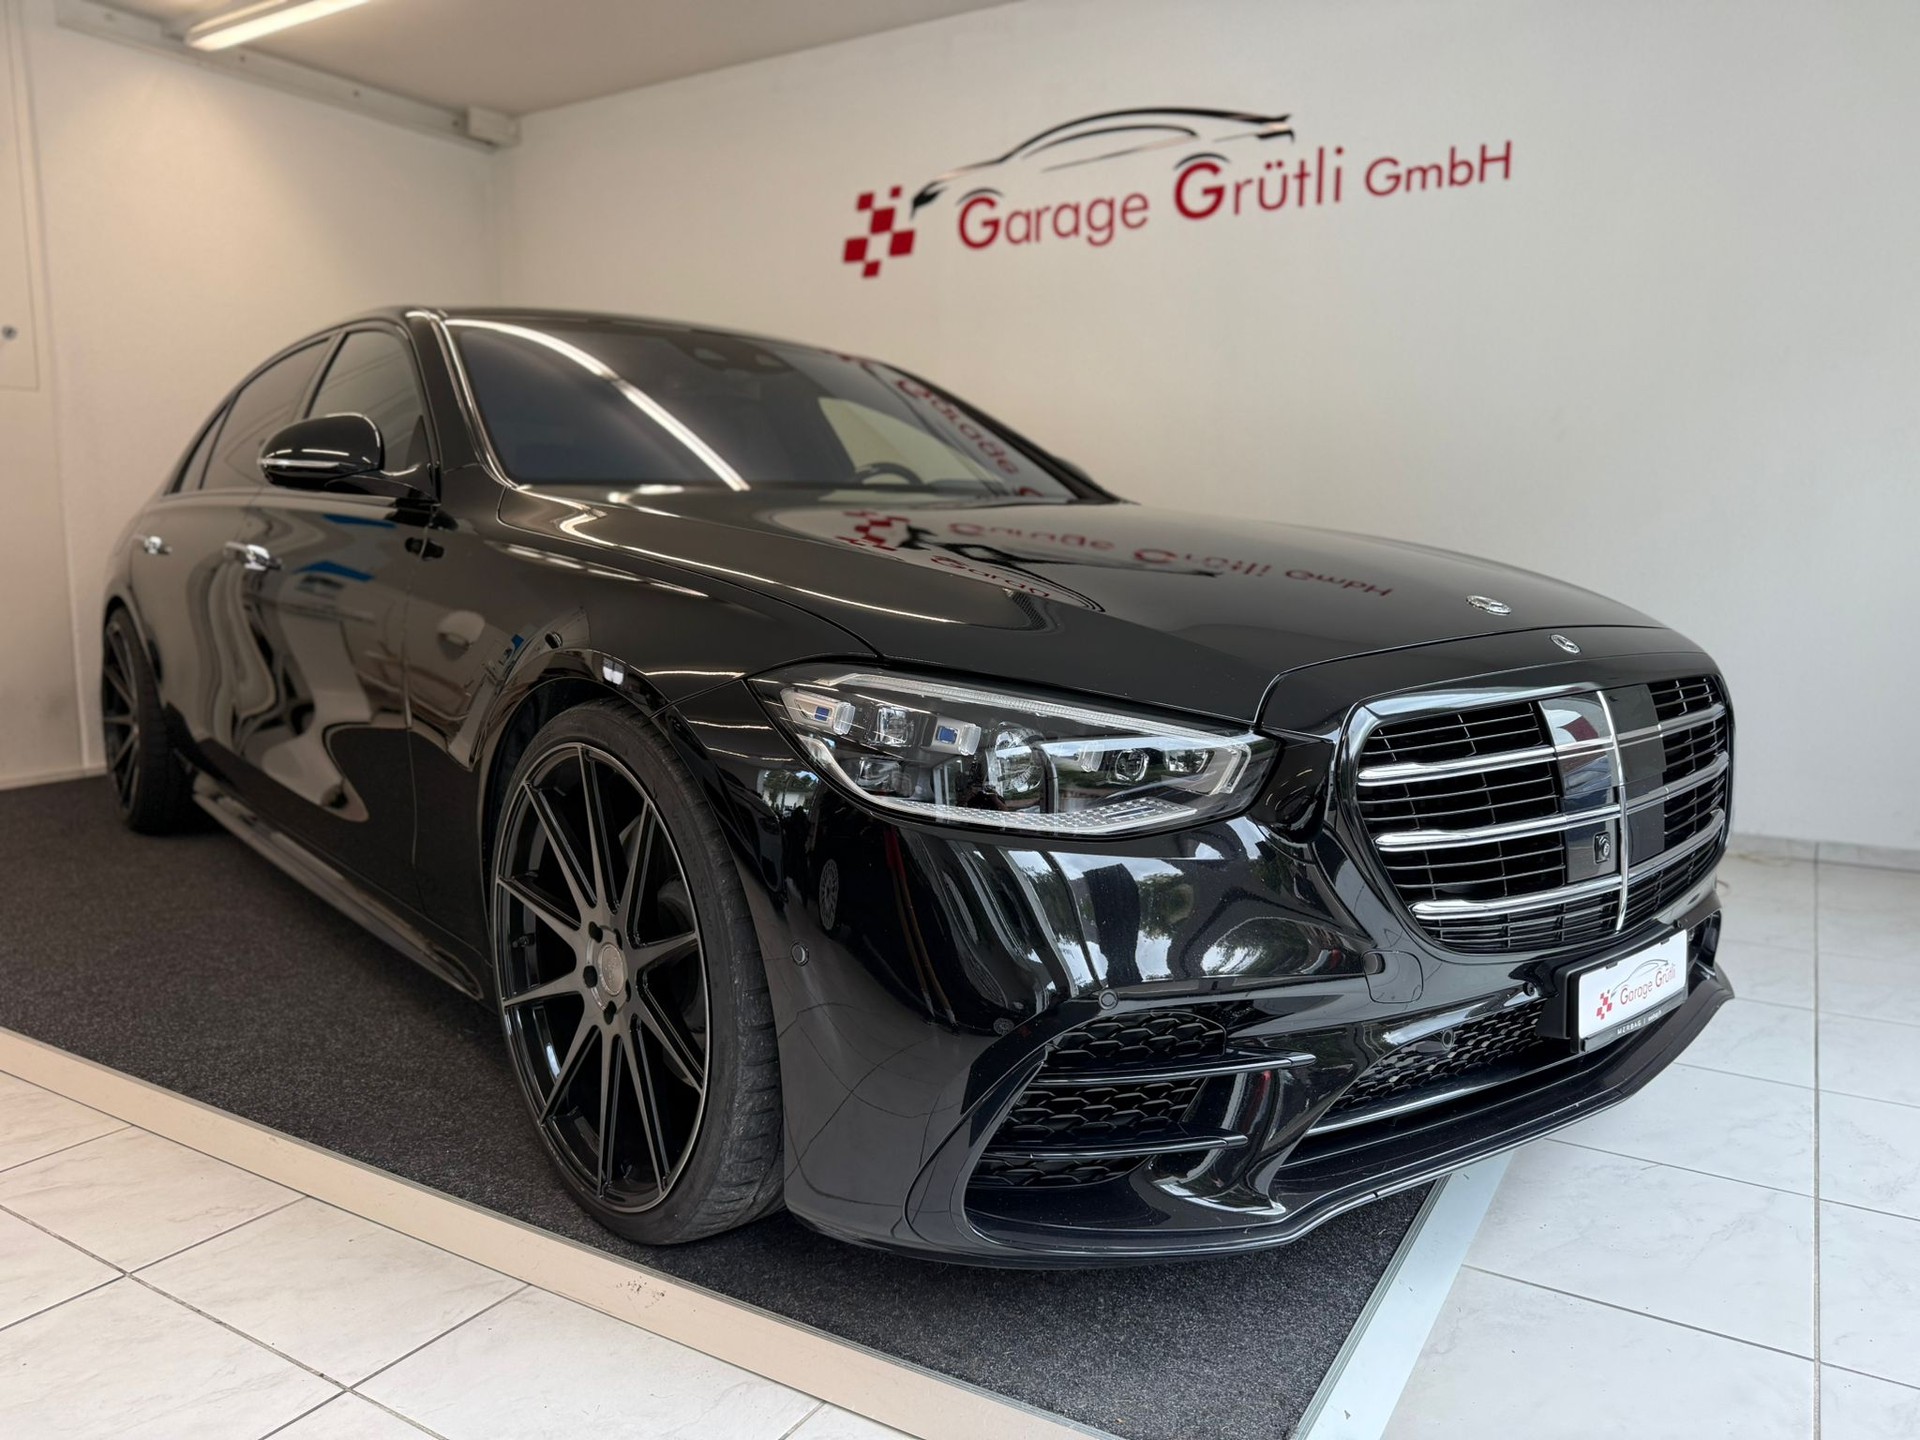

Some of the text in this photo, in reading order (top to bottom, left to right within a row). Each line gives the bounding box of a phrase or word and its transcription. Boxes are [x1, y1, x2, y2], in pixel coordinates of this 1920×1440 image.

[956, 140, 1513, 252] Garage Grütli GmbH
[1620, 980, 1653, 1005] Garage
